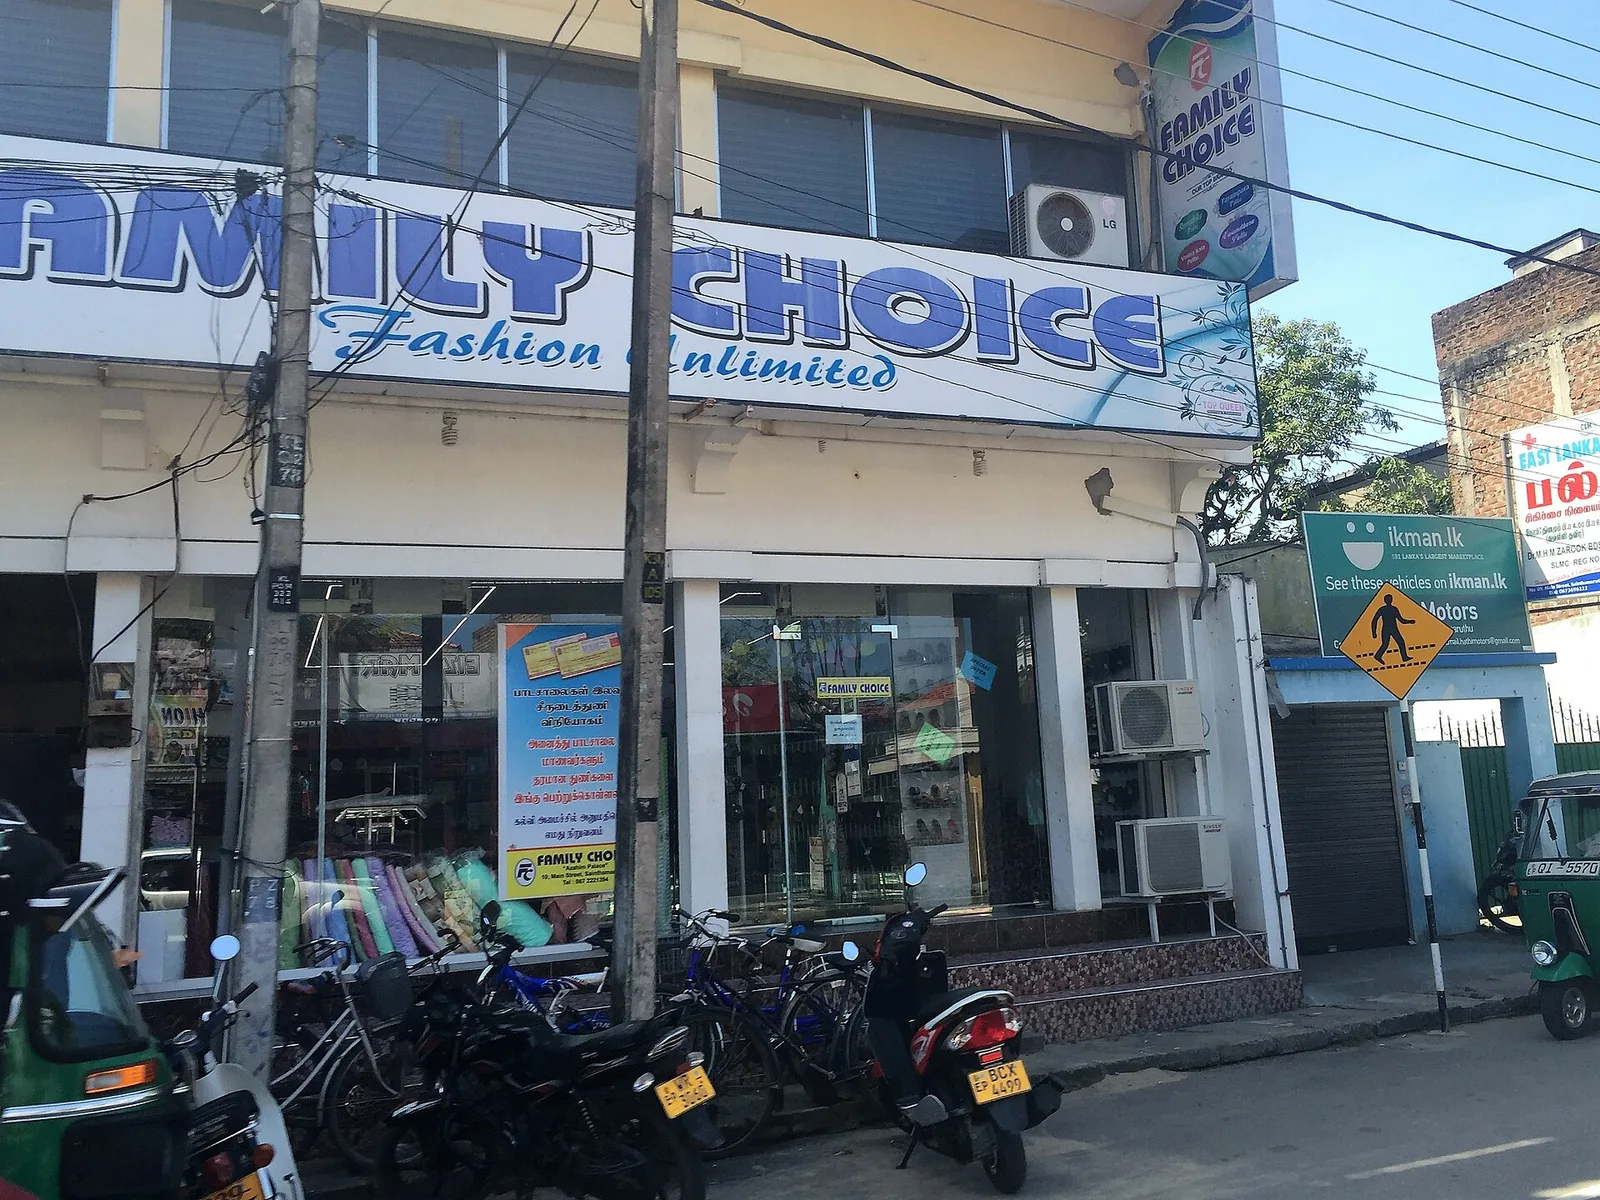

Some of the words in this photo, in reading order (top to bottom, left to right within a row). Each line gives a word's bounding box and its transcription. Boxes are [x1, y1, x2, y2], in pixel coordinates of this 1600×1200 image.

[1160, 66, 1252, 152] FAMILY
[1163, 104, 1256, 186] CHOICE
[1102, 218, 1117, 230] LG
[669, 245, 1168, 377] CHOICE
[318, 303, 604, 370] Fashion
[1203, 400, 1218, 410] TOP
[1219, 402, 1244, 412] QUEEN
[1519, 446, 1550, 470] EAST
[1555, 436, 1600, 463] LANKA
[1388, 525, 1465, 548] ikman.lk
[1551, 560, 1570, 569] SLMC
[1573, 558, 1588, 566] REG
[1325, 575, 1349, 590] See
[1350, 573, 1383, 590] these
[1386, 573, 1432, 589] vehicles
[1434, 577, 1447, 589] on
[1448, 572, 1508, 589] ikman.lk
[1421, 601, 1479, 621] Motors
[827, 684, 857, 693] FAMILY
[860, 683, 889, 693] CHOICE
[537, 852, 583, 867] FAMILY
[988, 1063, 1017, 1082] BCX
[975, 1080, 989, 1093] EP
[992, 1077, 1022, 1096] 4499
